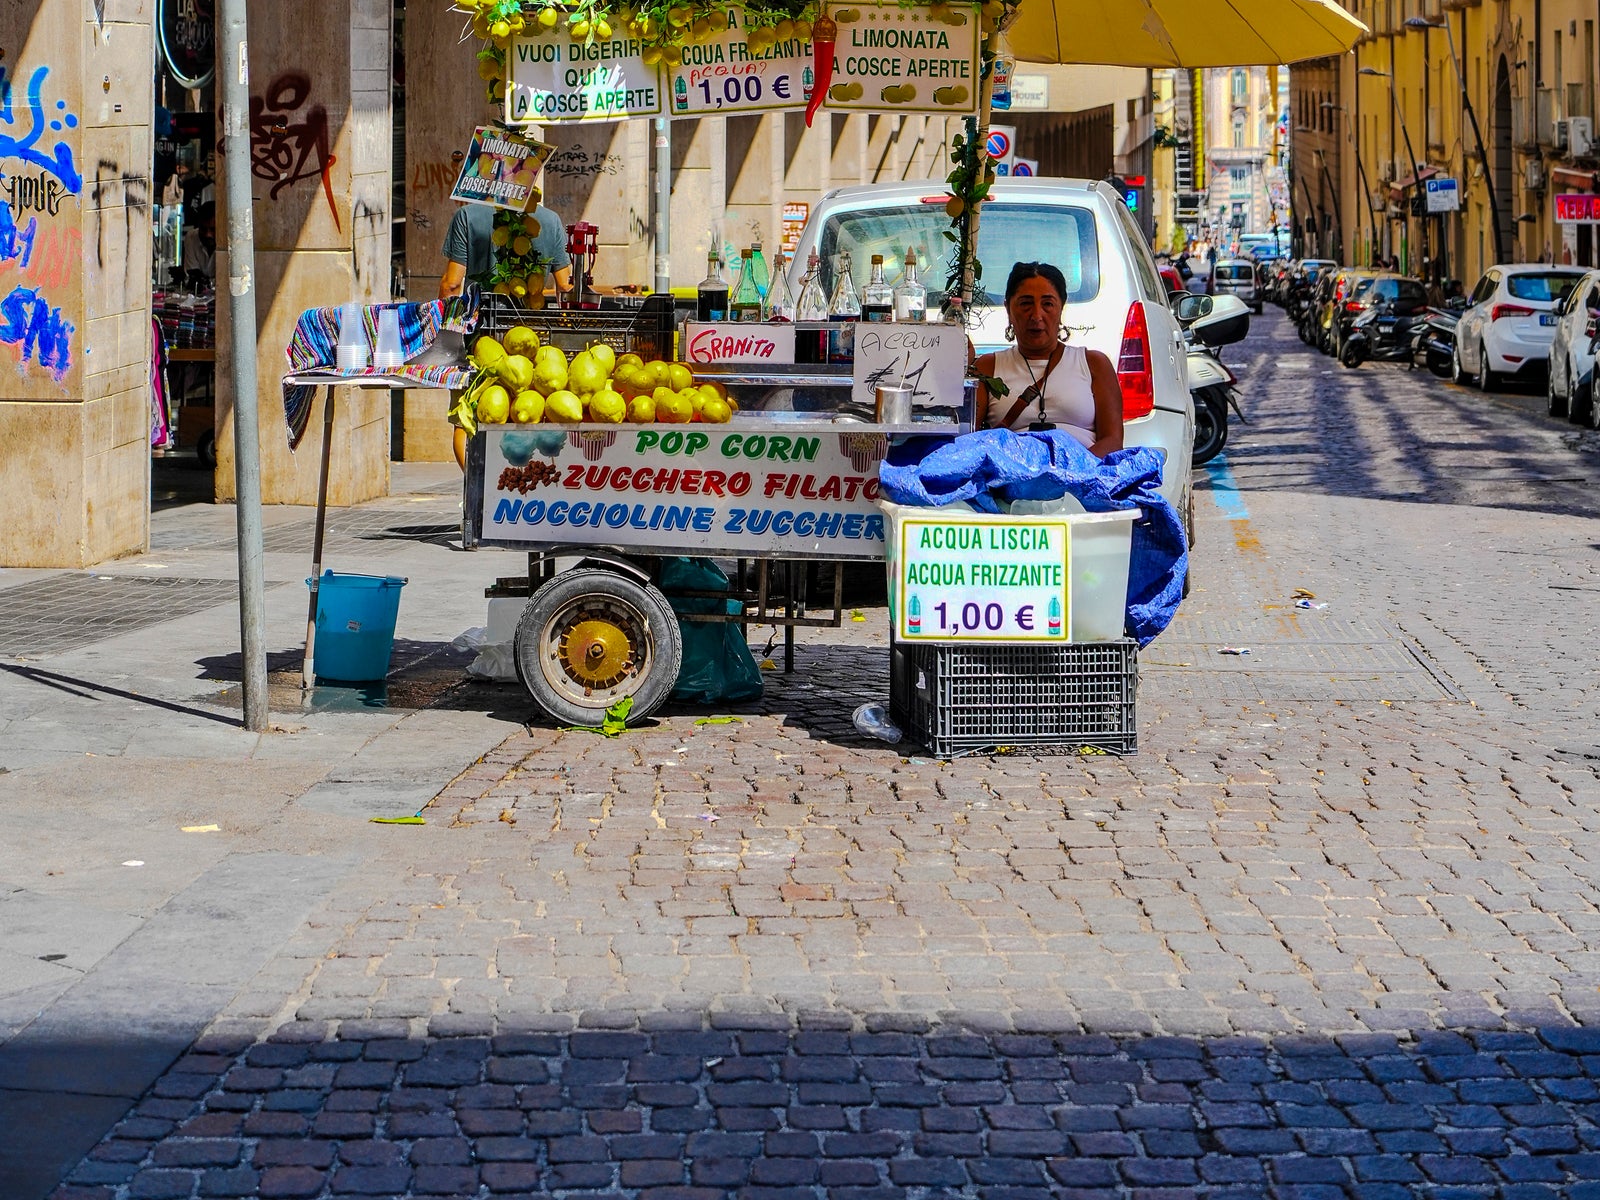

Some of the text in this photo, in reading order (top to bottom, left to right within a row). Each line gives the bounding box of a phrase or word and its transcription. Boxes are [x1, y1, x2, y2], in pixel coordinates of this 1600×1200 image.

[852, 29, 950, 49] LIMONATA
[517, 44, 561, 63] VUOI
[681, 43, 725, 66] CQUA
[690, 61, 768, 88] ACQUA?
[846, 56, 901, 76] COSCE
[906, 58, 970, 78] APERTE
[517, 88, 655, 113] A COSCE APERTE
[698, 75, 792, 109] 1,00 €
[480, 138, 530, 160] LIMONATA
[490, 160, 500, 175] A
[459, 176, 490, 194] COSCE
[487, 179, 527, 201] APERTE
[1557, 197, 1600, 220] KEBAB
[861, 332, 941, 357] ACQUA
[635, 431, 822, 463] POP CORN
[562, 464, 881, 501] ZUCCHERO FILATO
[493, 498, 716, 533] NOCCIOLINE
[920, 527, 1049, 551] ACQUA LISCIA
[907, 563, 1062, 587] ACQUA FRIZZANTE
[934, 602, 1034, 636] 1,00 €
